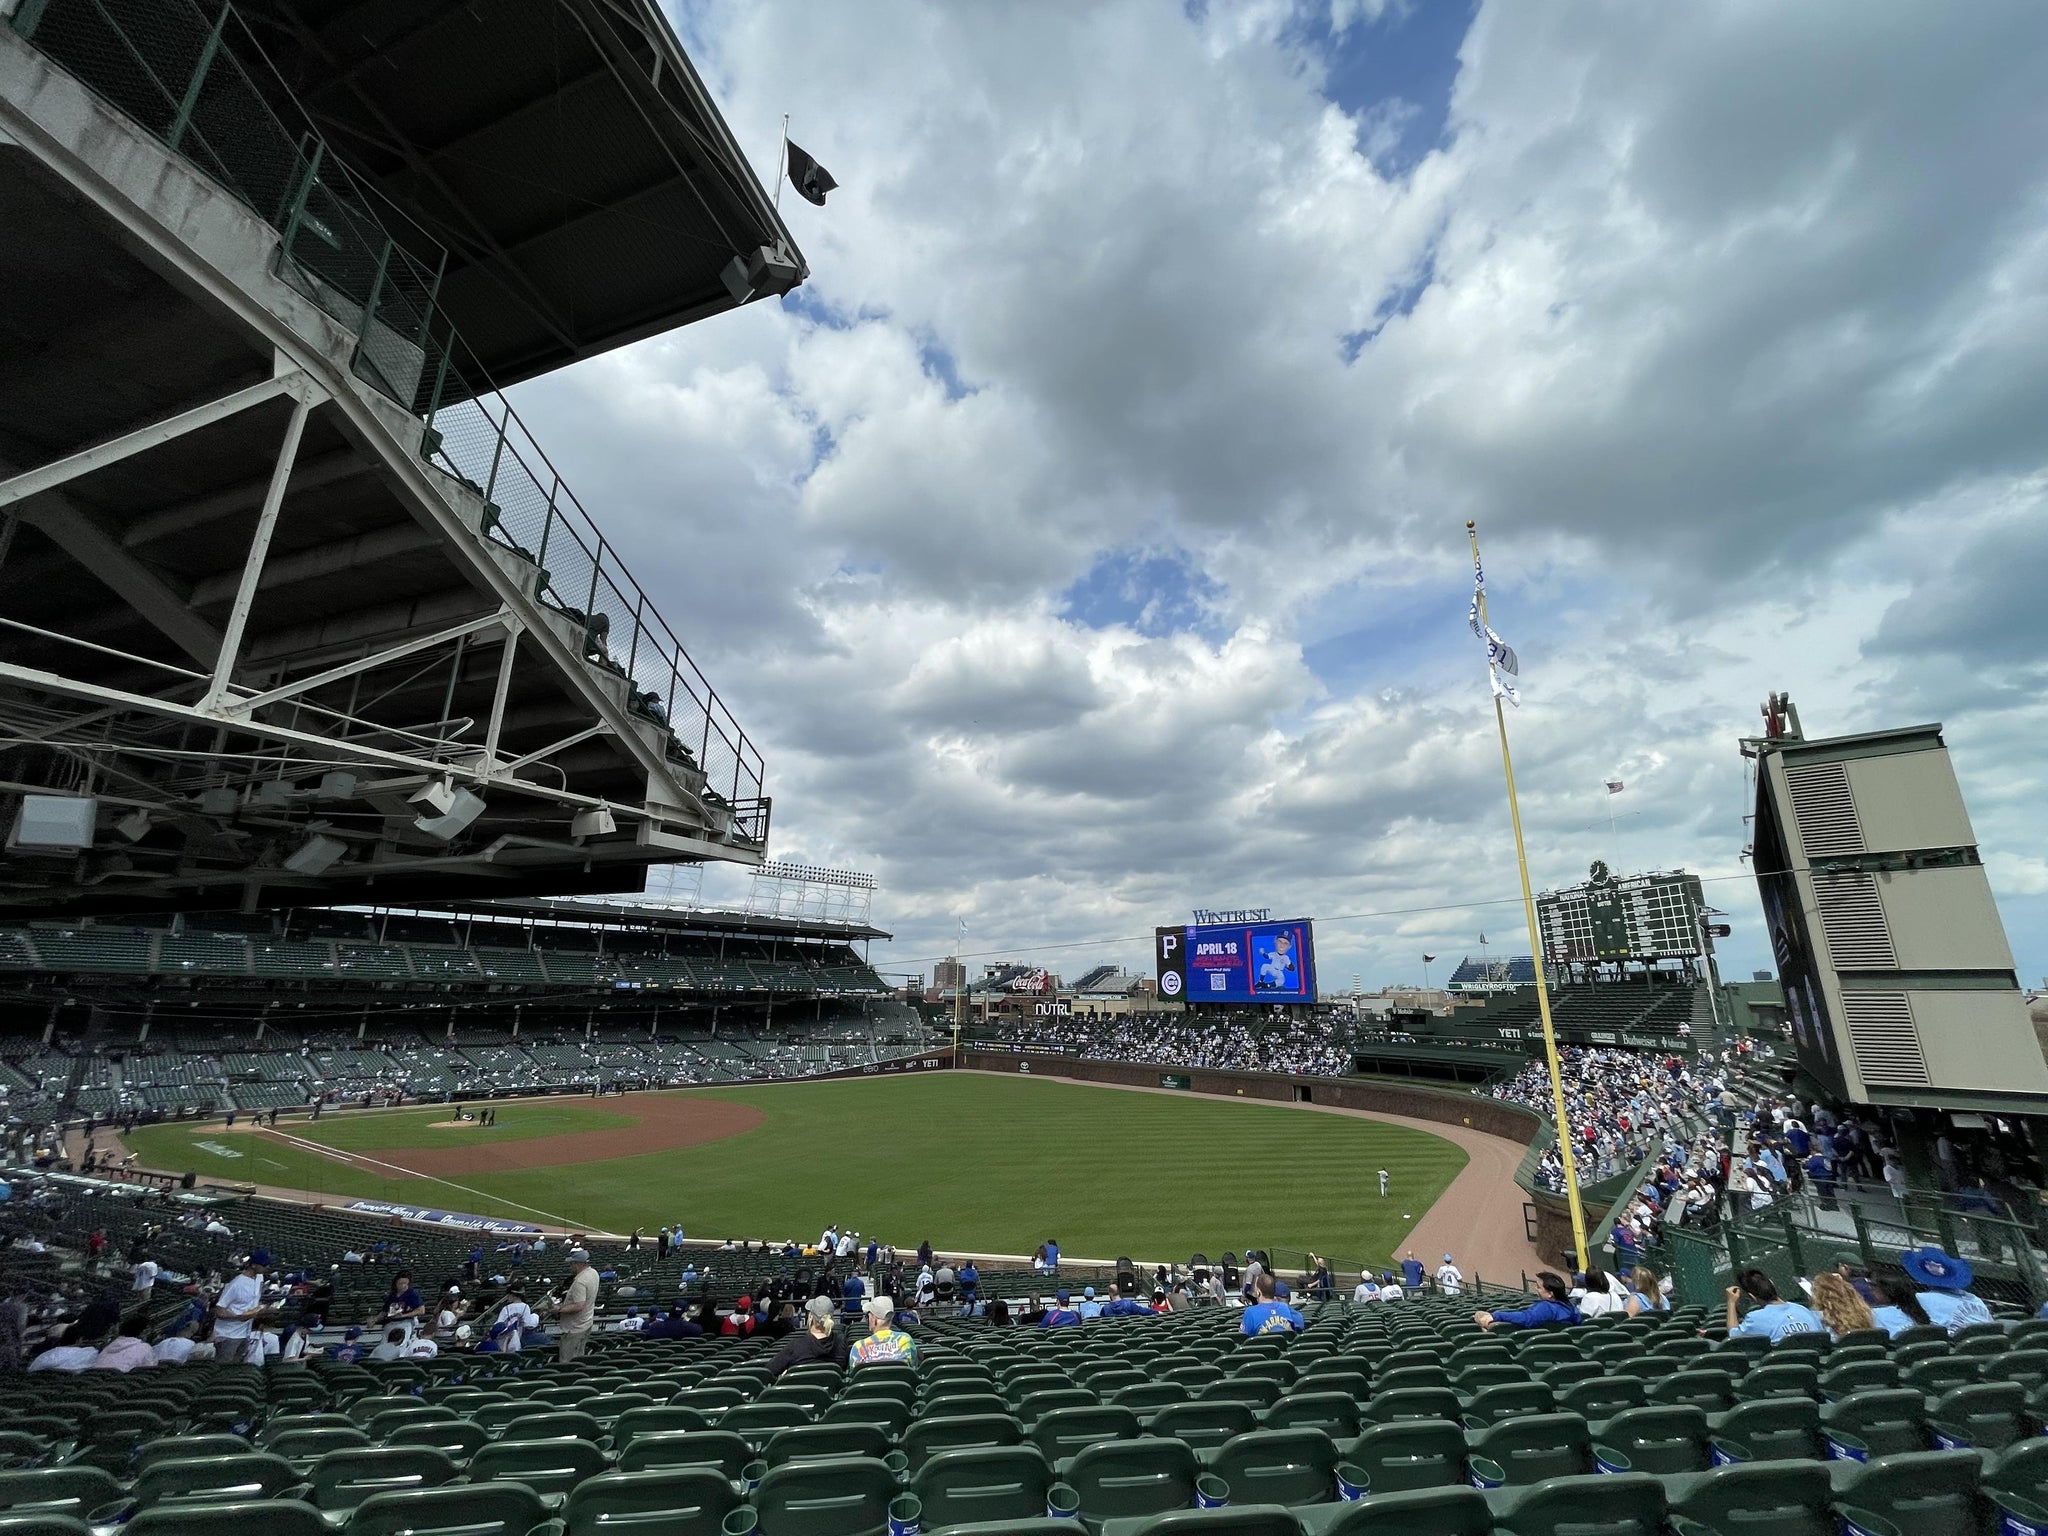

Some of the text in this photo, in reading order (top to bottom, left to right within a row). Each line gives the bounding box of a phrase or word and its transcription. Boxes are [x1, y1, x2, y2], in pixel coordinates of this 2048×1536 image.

[1618, 879, 1651, 891] AMERICAN
[1560, 890, 1588, 901] NATIONAL
[1192, 908, 1271, 924] WINTRUST
[1163, 936, 1177, 959] P
[1196, 942, 1238, 955] APRIL 18
[1498, 1028, 1521, 1038] YETI
[1622, 1034, 1657, 1046] Budweiser
[922, 1059, 939, 1068] YETI
